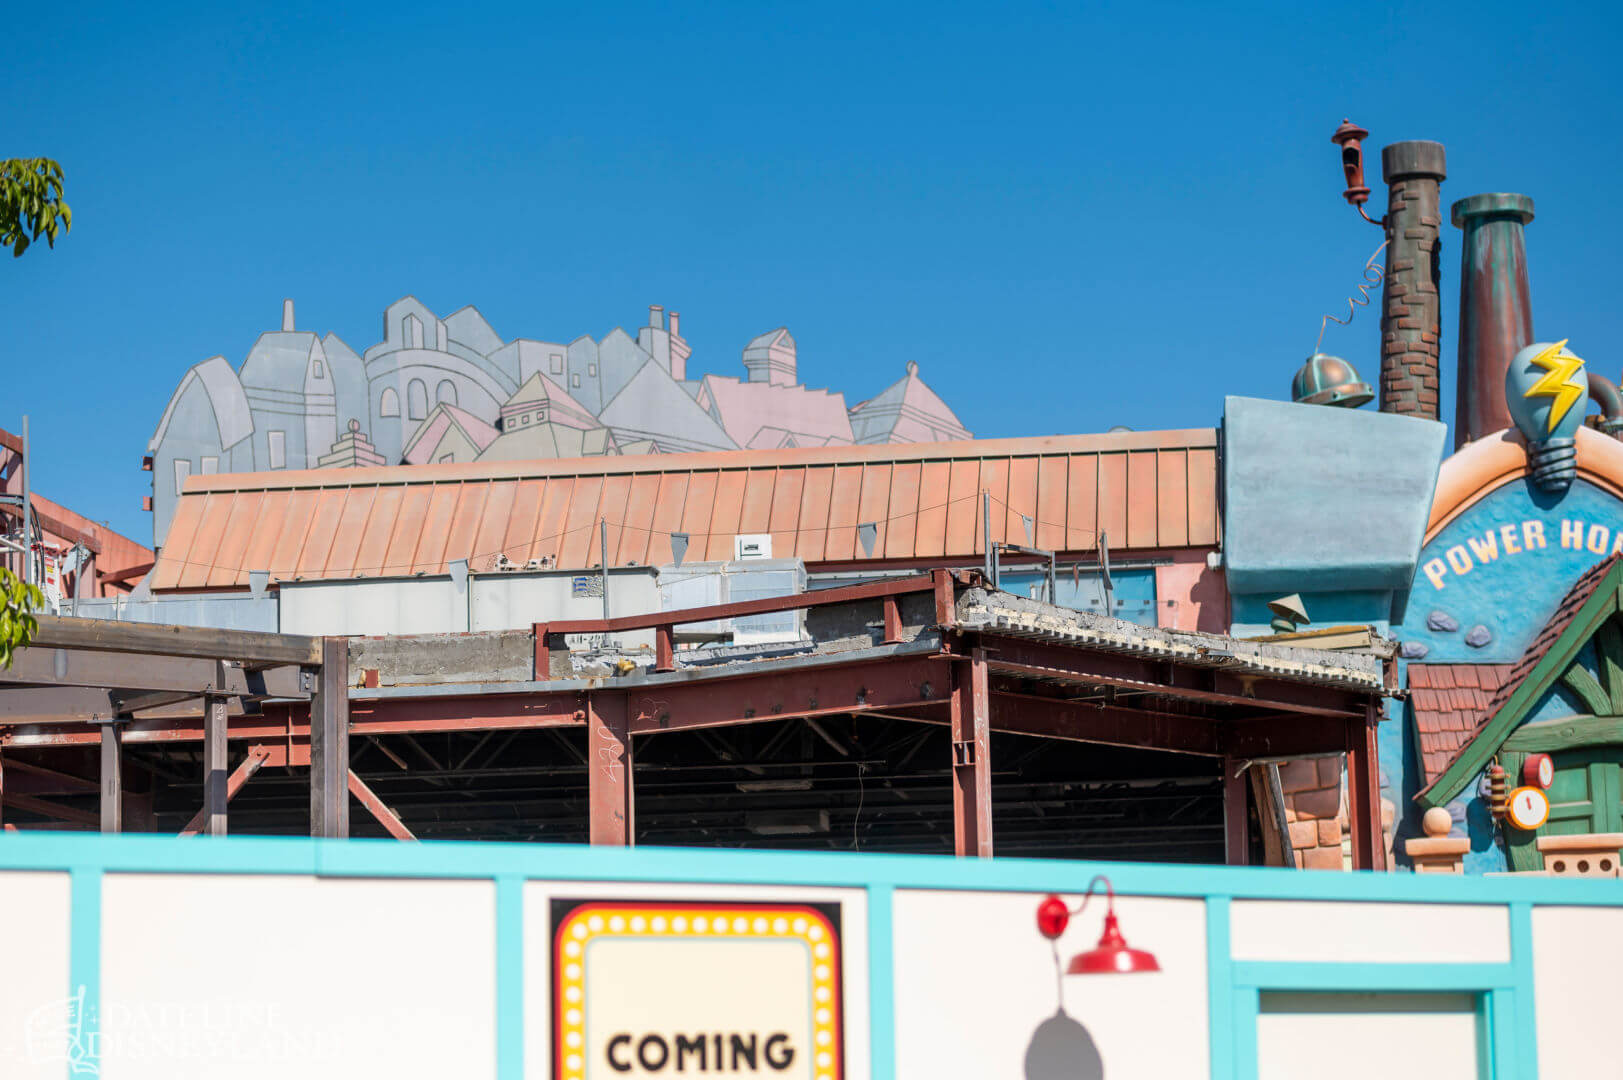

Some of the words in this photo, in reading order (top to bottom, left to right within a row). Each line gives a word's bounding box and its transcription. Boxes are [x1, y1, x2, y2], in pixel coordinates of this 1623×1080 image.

[1422, 519, 1547, 590] POWER
[1561, 519, 1623, 554] HO
[606, 1033, 795, 1072] COMING
